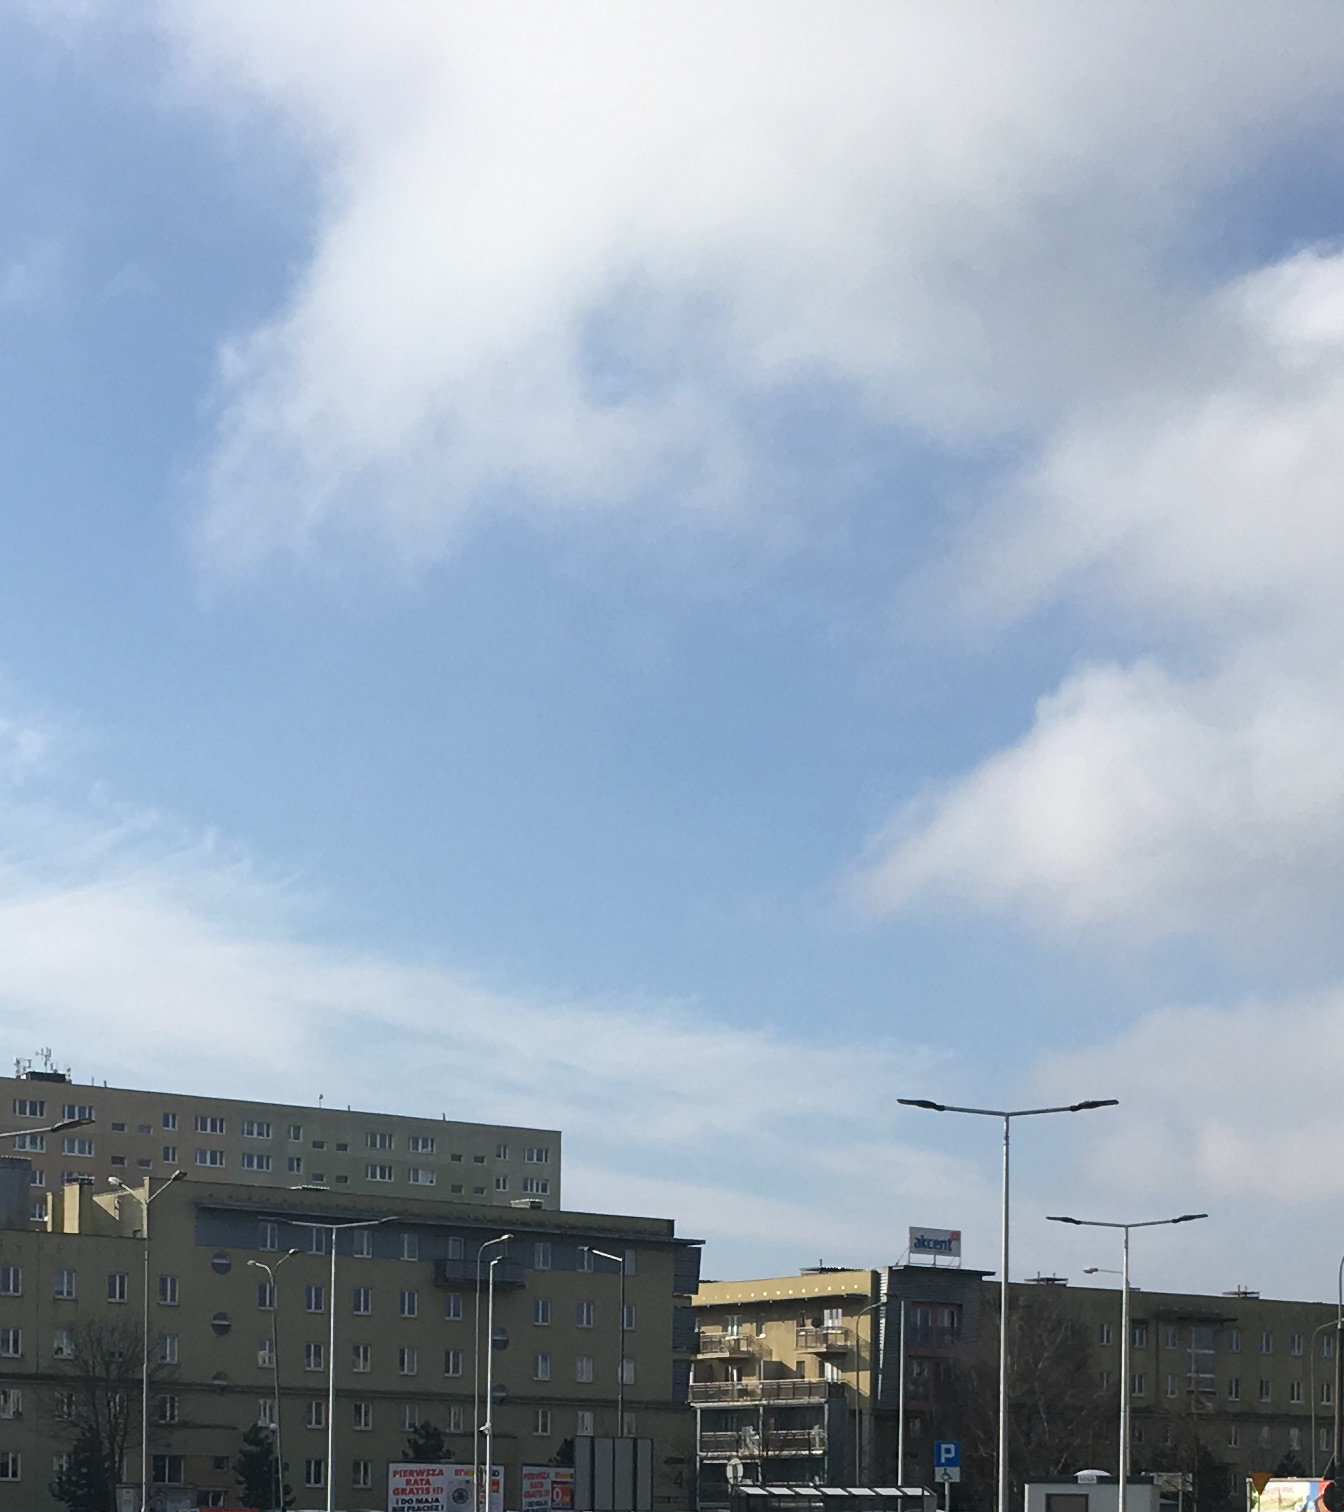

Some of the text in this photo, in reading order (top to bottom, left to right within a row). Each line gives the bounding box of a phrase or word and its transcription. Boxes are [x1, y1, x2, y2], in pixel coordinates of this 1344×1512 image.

[914, 1234, 953, 1251] akcent
[941, 1443, 955, 1463] P
[392, 1468, 444, 1477] PIERWSZA
[405, 1478, 431, 1486] RATA
[392, 1487, 430, 1496] GRATIS
